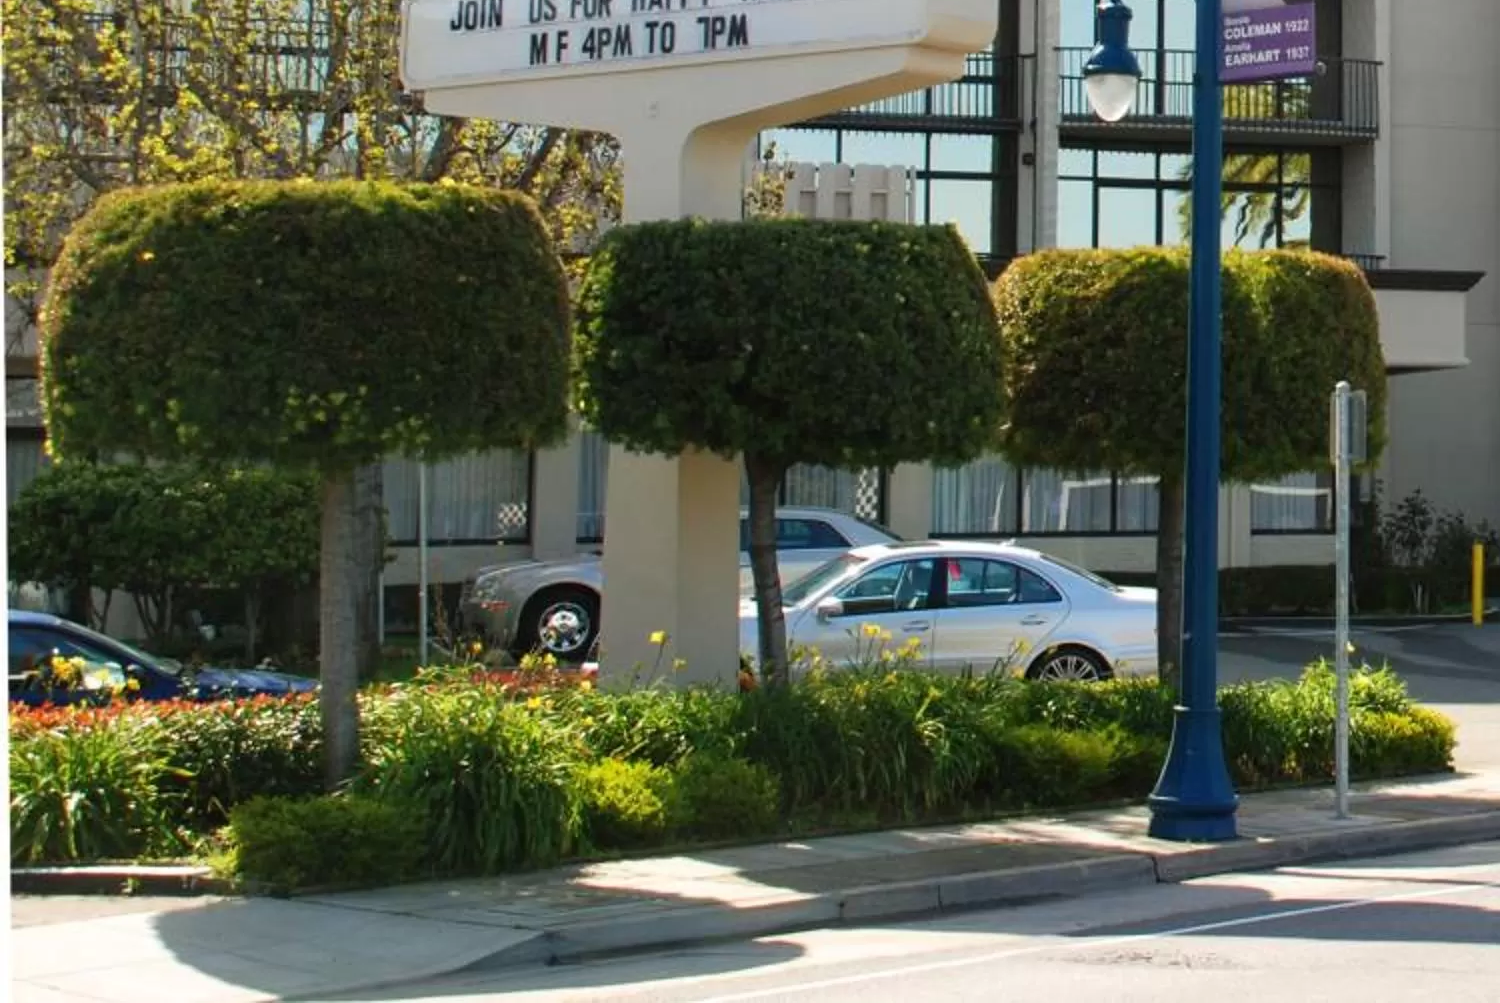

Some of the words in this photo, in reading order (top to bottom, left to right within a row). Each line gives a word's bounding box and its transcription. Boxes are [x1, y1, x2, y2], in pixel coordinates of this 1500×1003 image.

[581, 23, 633, 61] 4PM
[645, 20, 676, 55] TO
[696, 12, 749, 50] 7PM
[1223, 21, 1281, 40] COLEMAN
[1224, 48, 1281, 67] EARHART
